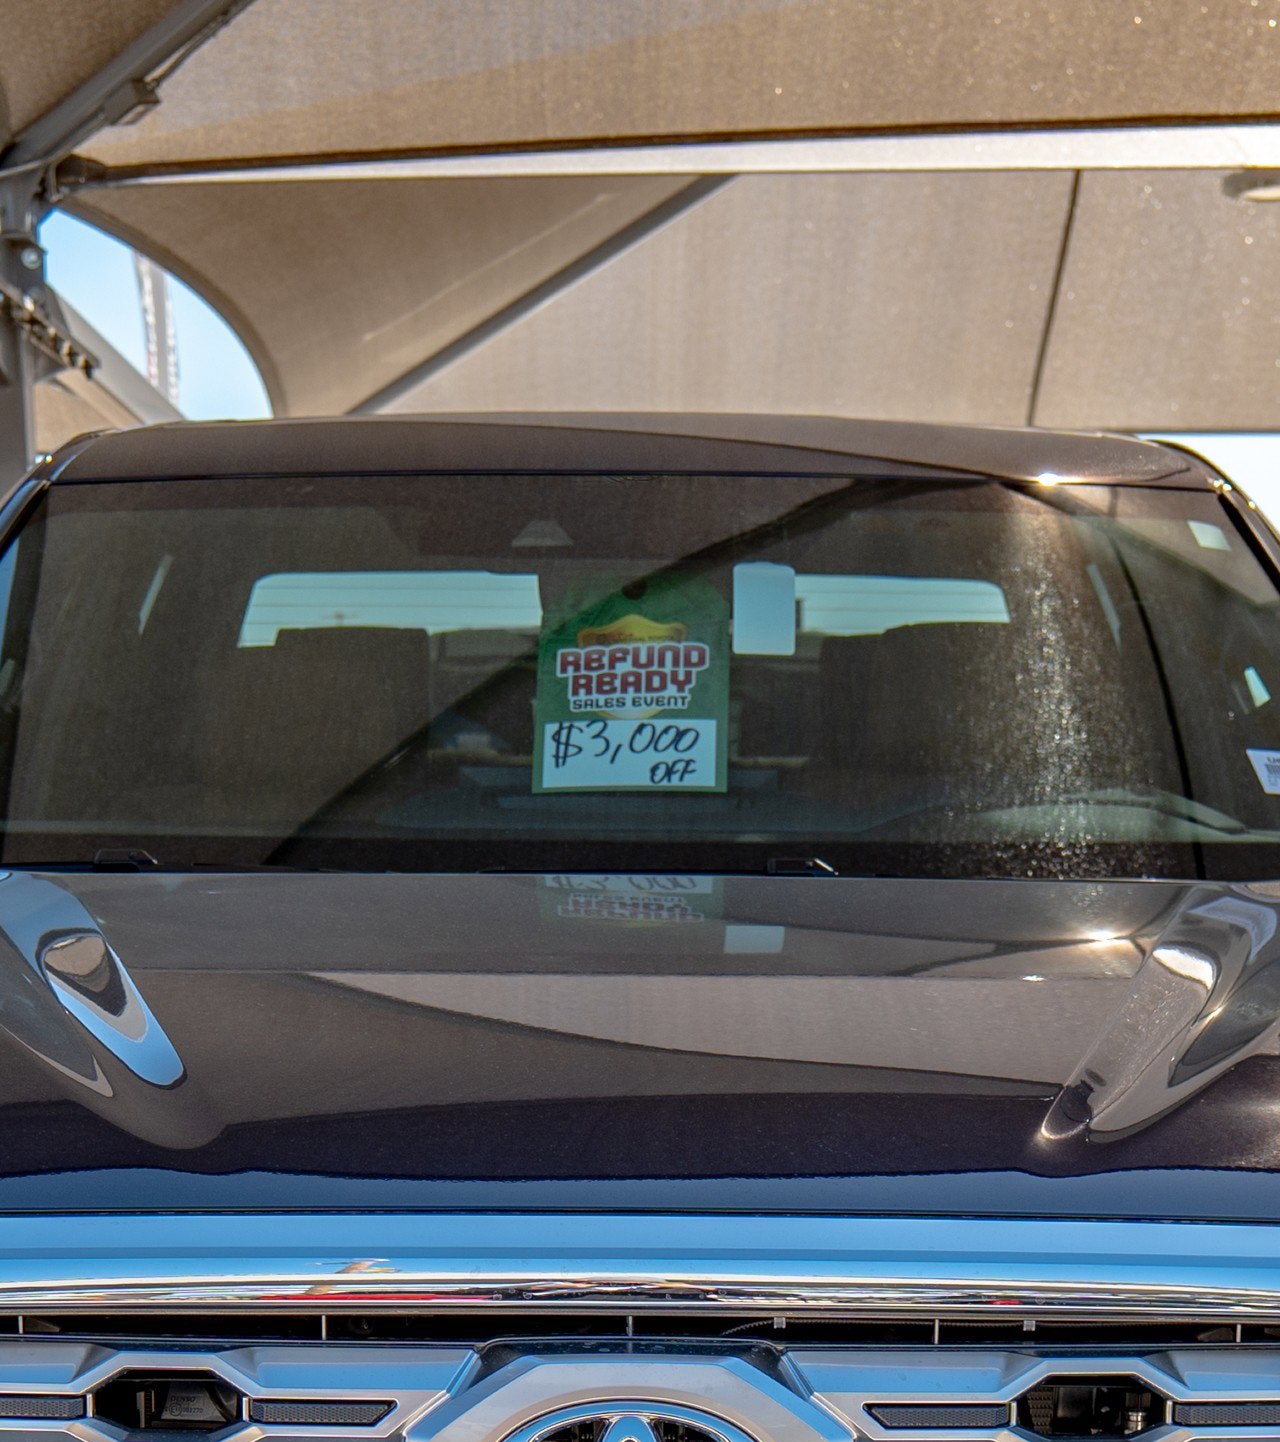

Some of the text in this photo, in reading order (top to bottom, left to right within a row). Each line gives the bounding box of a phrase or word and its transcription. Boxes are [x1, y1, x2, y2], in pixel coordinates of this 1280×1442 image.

[559, 644, 708, 675] REFUND
[571, 669, 694, 697] READY
[571, 695, 688, 710] SALES EVENT
[551, 719, 700, 769] $3,000
[649, 758, 697, 784] OFF
